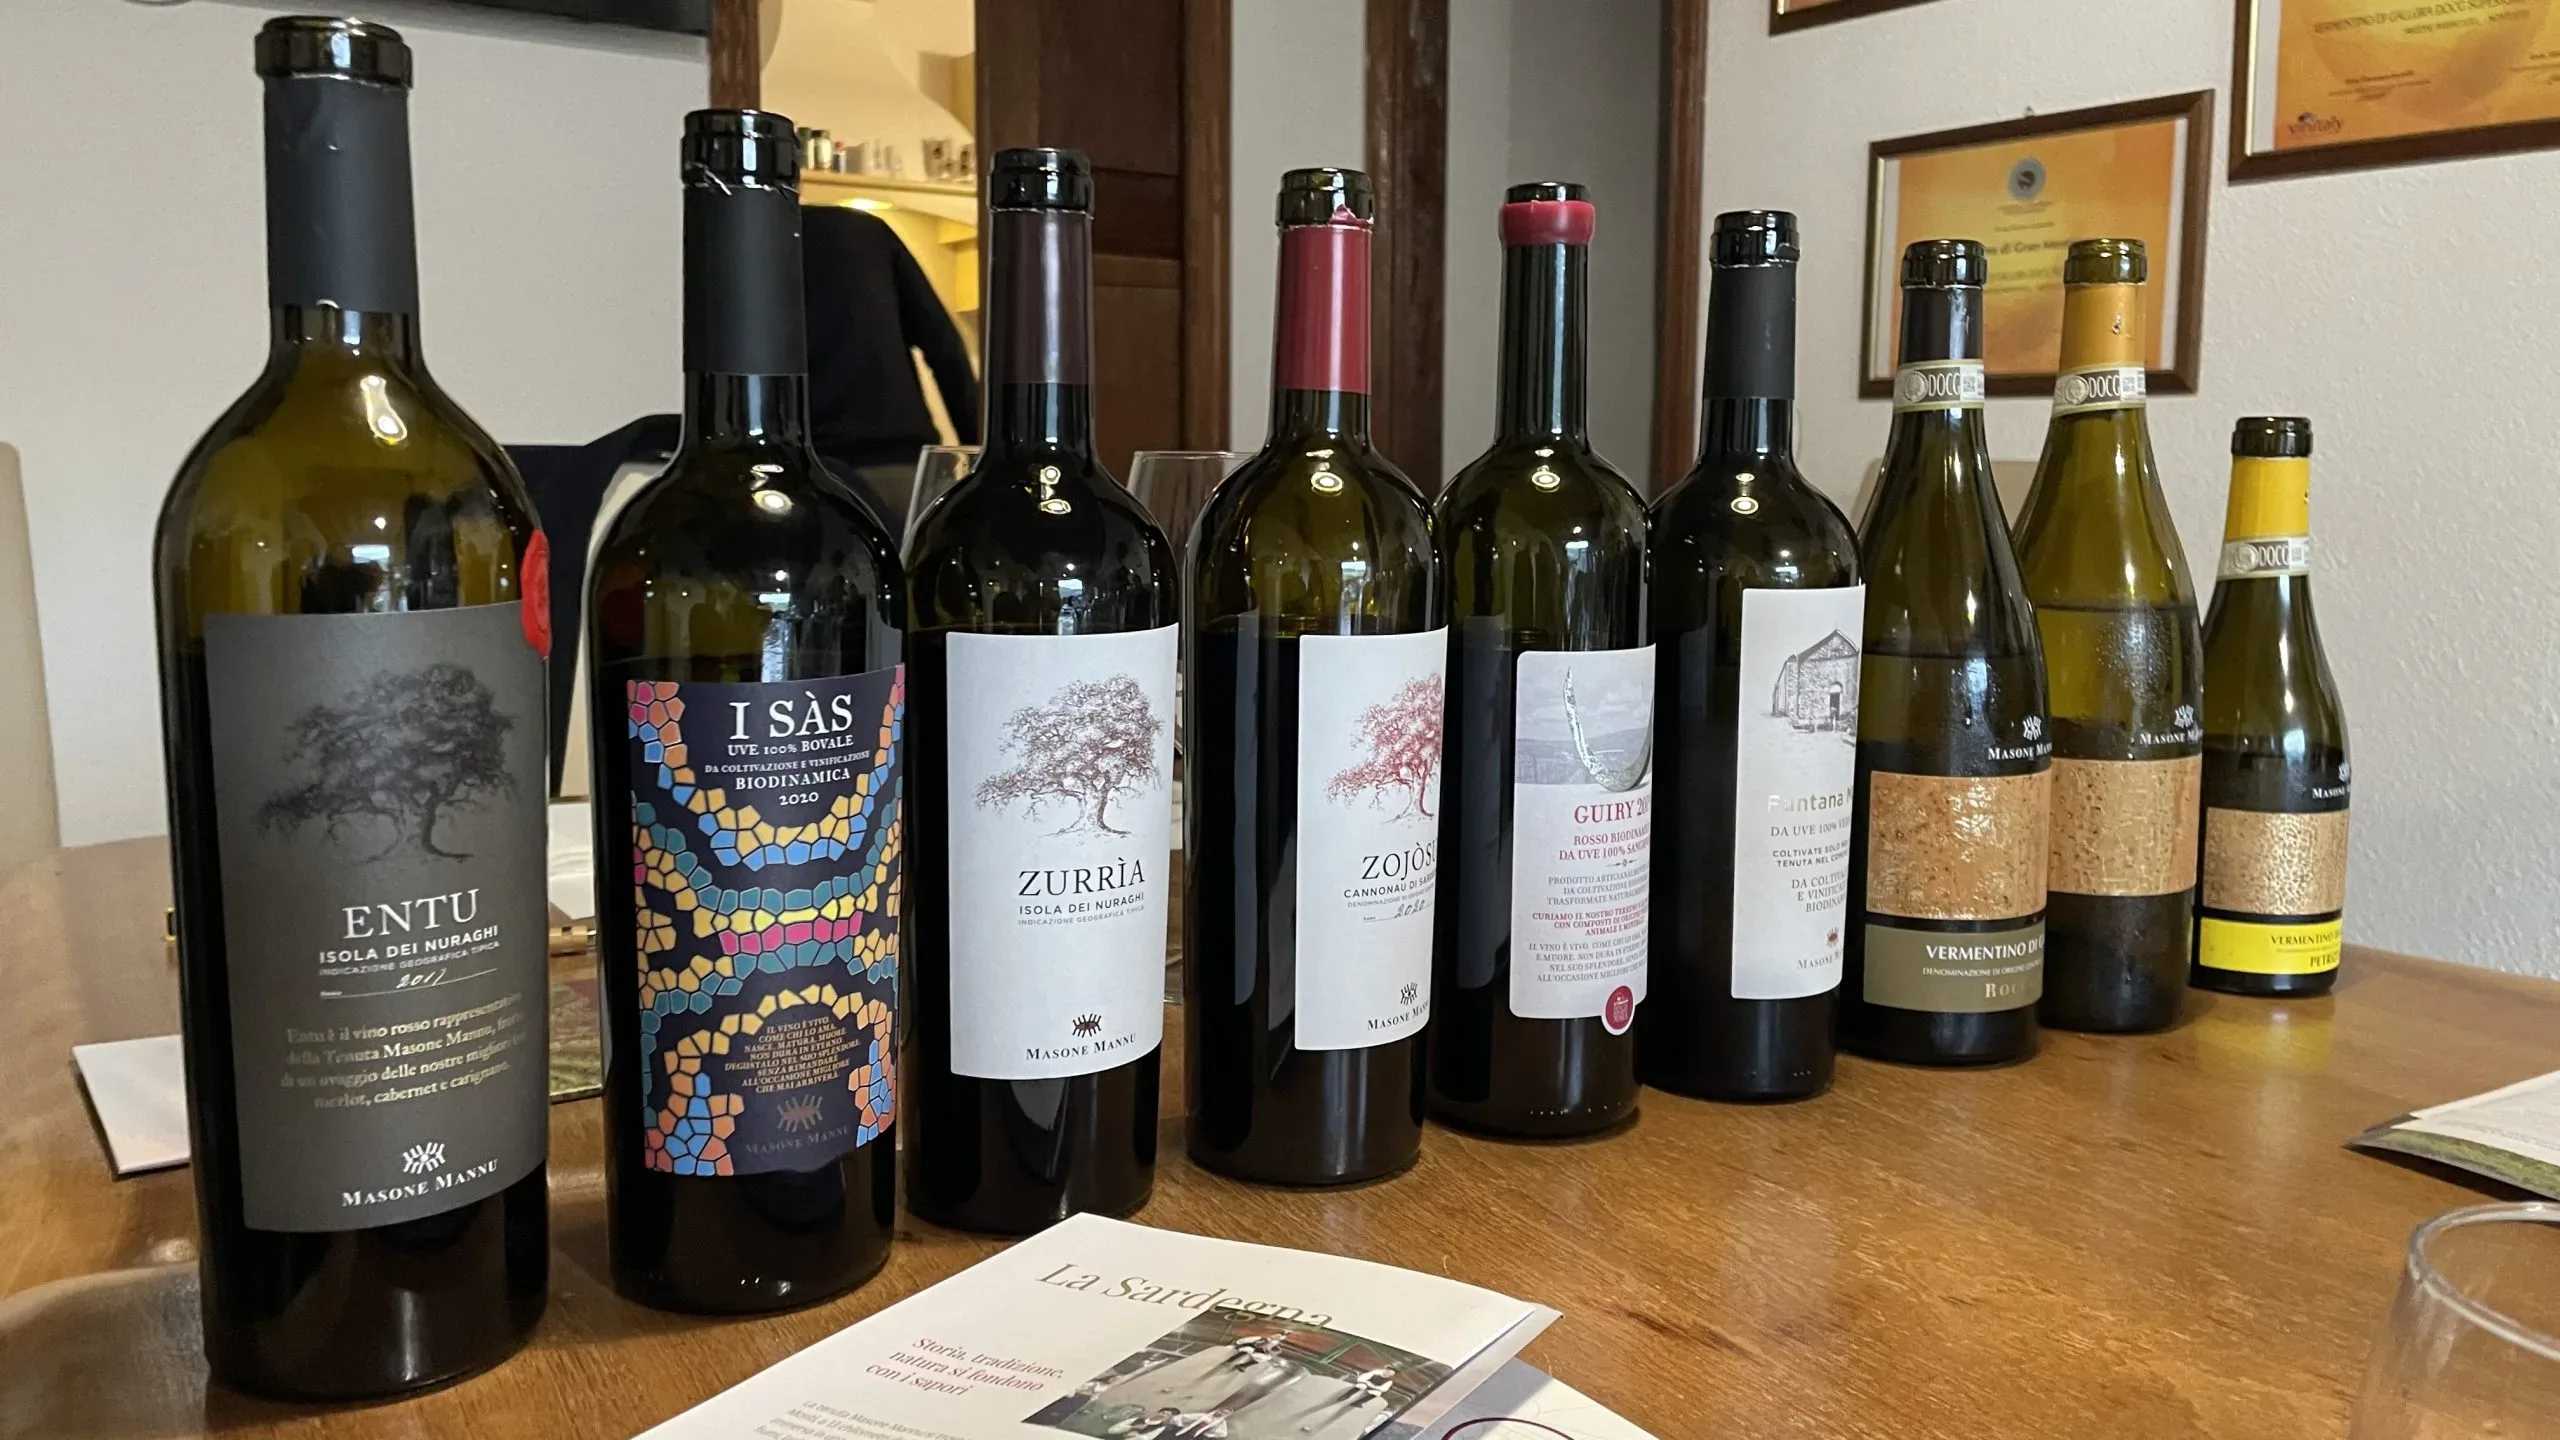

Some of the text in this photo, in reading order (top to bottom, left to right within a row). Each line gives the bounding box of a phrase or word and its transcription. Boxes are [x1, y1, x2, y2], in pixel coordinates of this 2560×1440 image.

[1928, 372, 1961, 397] DOCG
[729, 690, 853, 740] I SÀS
[727, 734, 854, 757] UVE 100% BOVALE
[704, 750, 871, 774] DA COLTIVAZIONE E VINIFICAZIONE
[735, 767, 851, 791] BIODINAMICA
[778, 791, 820, 807] 2020
[1574, 800, 1634, 824] GUIRY
[1573, 833, 1609, 847] ROSSO
[1771, 825, 1789, 837] DA
[1793, 824, 1816, 837] UVE
[1559, 849, 1575, 861] DA
[1578, 848, 1601, 861] UVE
[1603, 845, 1626, 859] 100%
[1772, 846, 1823, 858] COLTIVATE
[1776, 858, 1813, 868] TENUTA
[1018, 856, 1146, 897] ZURRÌA
[1791, 878, 1808, 889] DA
[1343, 883, 1407, 899] CANNONAU
[1797, 891, 1805, 902] E
[341, 888, 480, 940] ENTU
[1019, 892, 1145, 916] ISOLA DEI NURAGHI
[1532, 911, 1574, 922] CURIAMO
[319, 925, 499, 965] ISOLA DEI NURAGHI
[1925, 941, 2027, 961] VERMENTINO
[352, 1025, 388, 1040] vino
[391, 1020, 431, 1037] rosso
[777, 1021, 801, 1032] VINO
[1367, 1012, 1411, 1031] MASONE
[383, 1038, 443, 1060] Masone
[1026, 1033, 1137, 1061] MASONE MANNU
[381, 1063, 417, 1081] delle
[420, 1054, 465, 1075] nostre
[373, 1082, 438, 1104] cabernet
[439, 1080, 449, 1092] e
[341, 1158, 500, 1208] MASONE MANNU
[1035, 1263, 1335, 1329] La Sardegna
[865, 1363, 902, 1381] con
[909, 1375, 974, 1397] sapori
[888, 1351, 1045, 1392] natura si fondono
